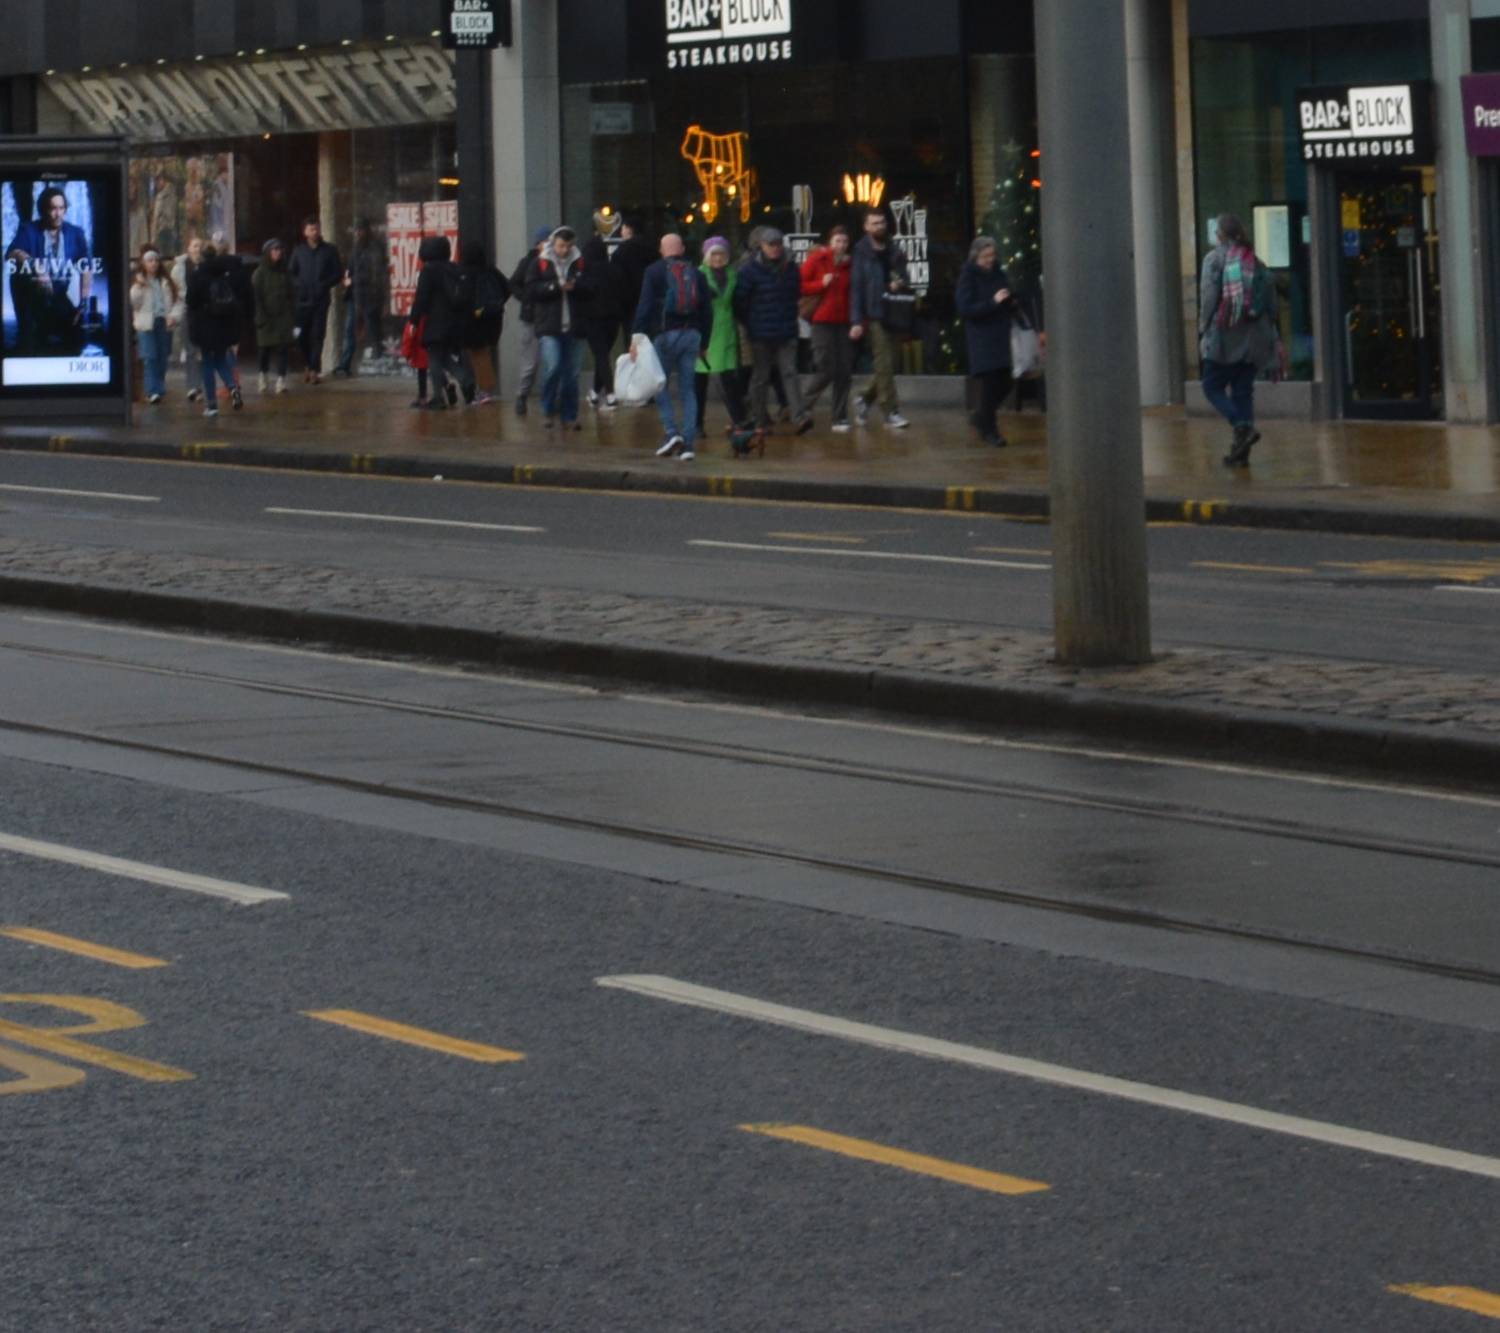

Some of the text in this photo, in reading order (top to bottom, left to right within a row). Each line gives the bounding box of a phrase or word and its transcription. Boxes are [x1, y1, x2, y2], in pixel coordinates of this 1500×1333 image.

[455, 16, 490, 29] BLOCK
[667, 39, 792, 68] STEAKHOUSE
[44, 44, 457, 129] URBAN OUTFITTER
[1355, 96, 1406, 128] BLOCK
[1304, 139, 1415, 159] STEAKHOUSE
[388, 206, 420, 229] SALE
[425, 204, 458, 228] SALE
[8, 256, 103, 275] SAUVAGE
[69, 359, 104, 372] DIOR
